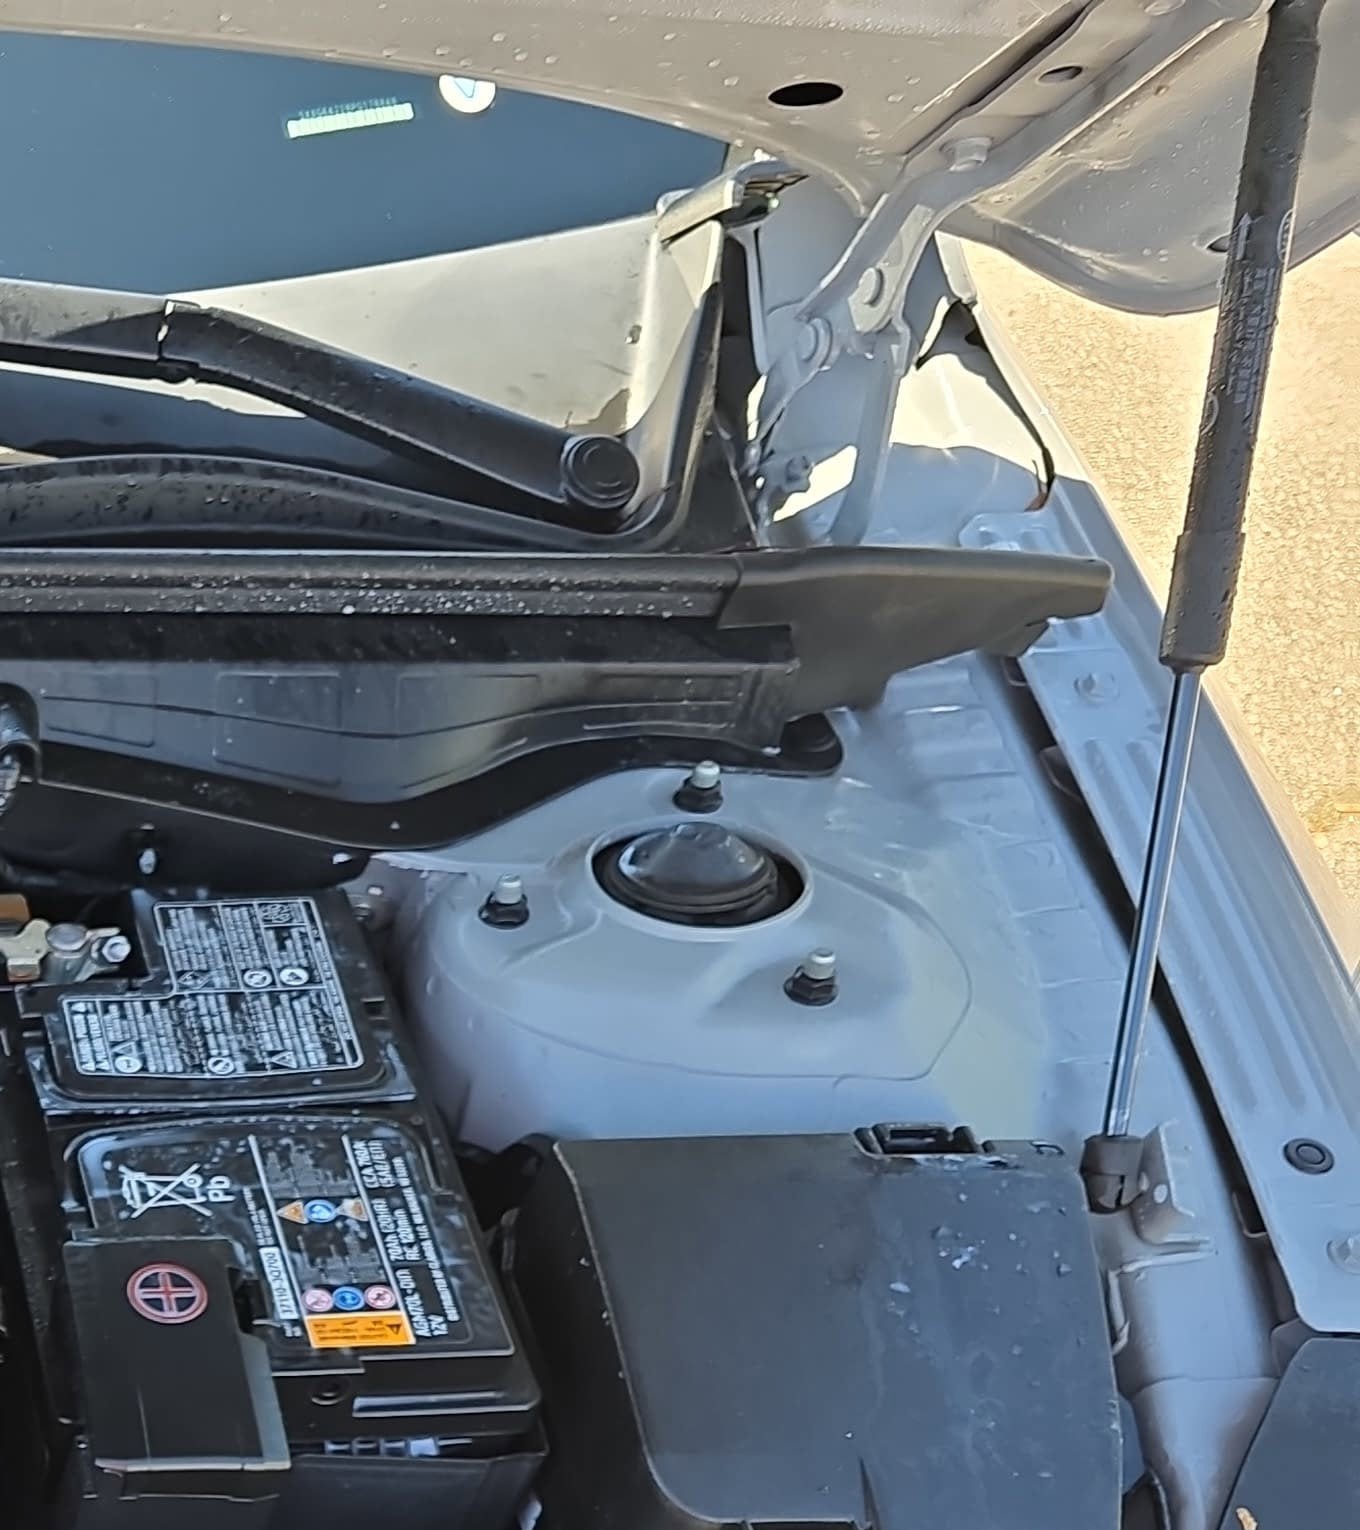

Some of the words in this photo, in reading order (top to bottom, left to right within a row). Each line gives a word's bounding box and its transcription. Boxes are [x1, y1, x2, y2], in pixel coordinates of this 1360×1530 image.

[206, 1174, 237, 1202] Pb
[361, 1164, 379, 1189] CCA
[383, 1233, 405, 1262] 70Ah
[428, 1314, 449, 1336] 12V
